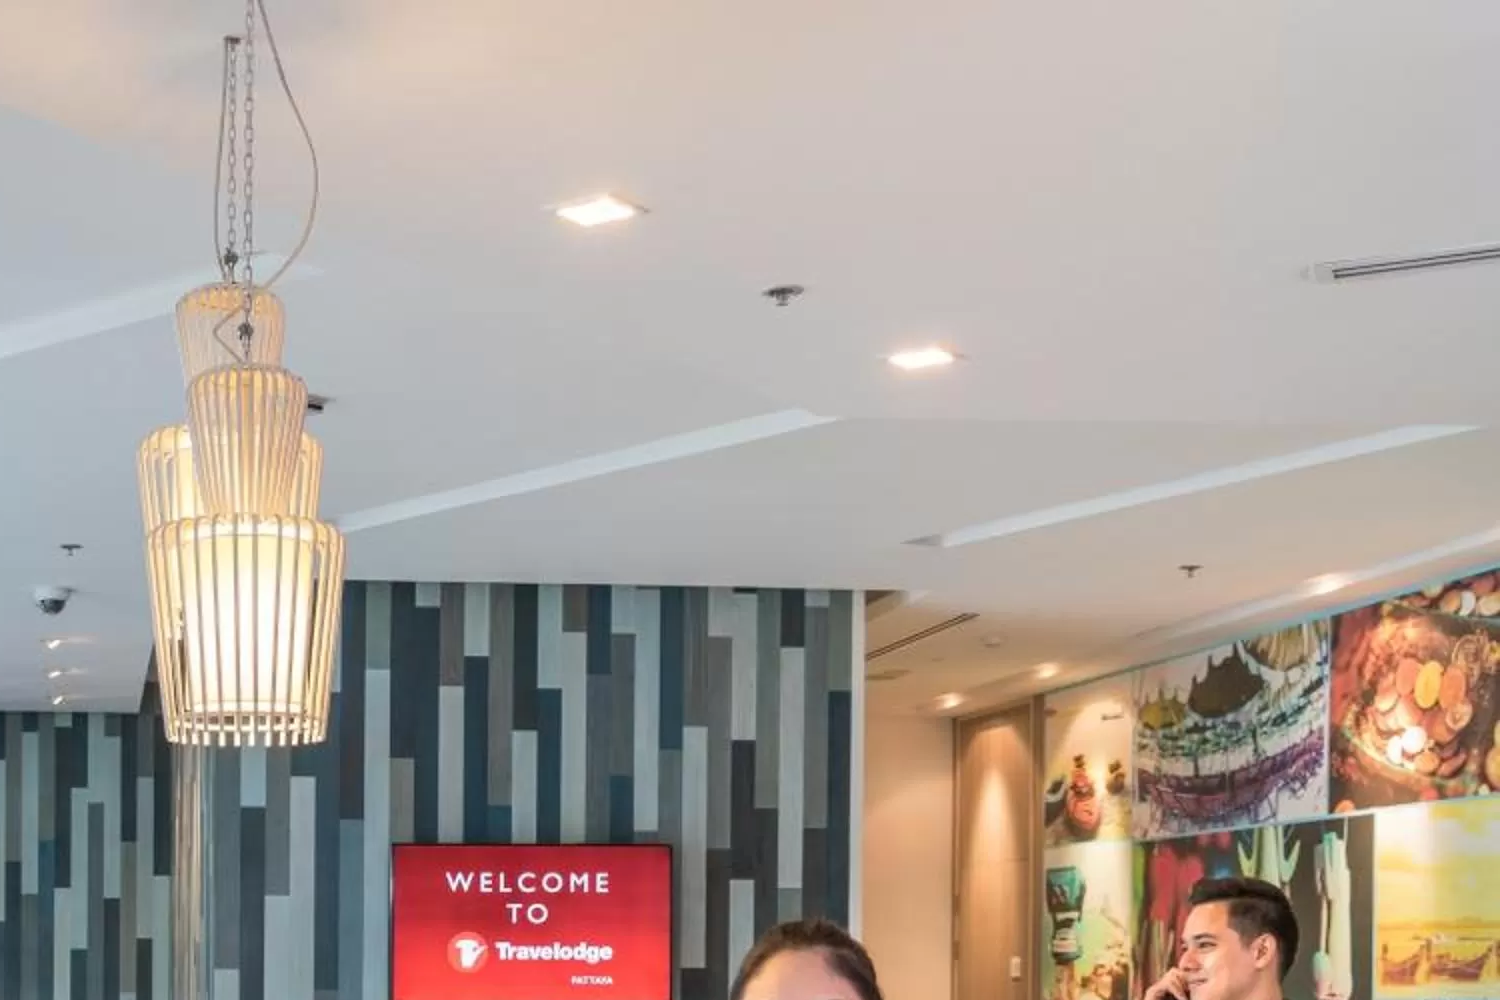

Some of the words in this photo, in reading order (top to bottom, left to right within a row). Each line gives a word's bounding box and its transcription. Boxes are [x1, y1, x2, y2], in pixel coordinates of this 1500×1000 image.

[446, 871, 610, 894] WELCOME
[505, 902, 549, 924] TO
[495, 941, 613, 963] Travelodge
